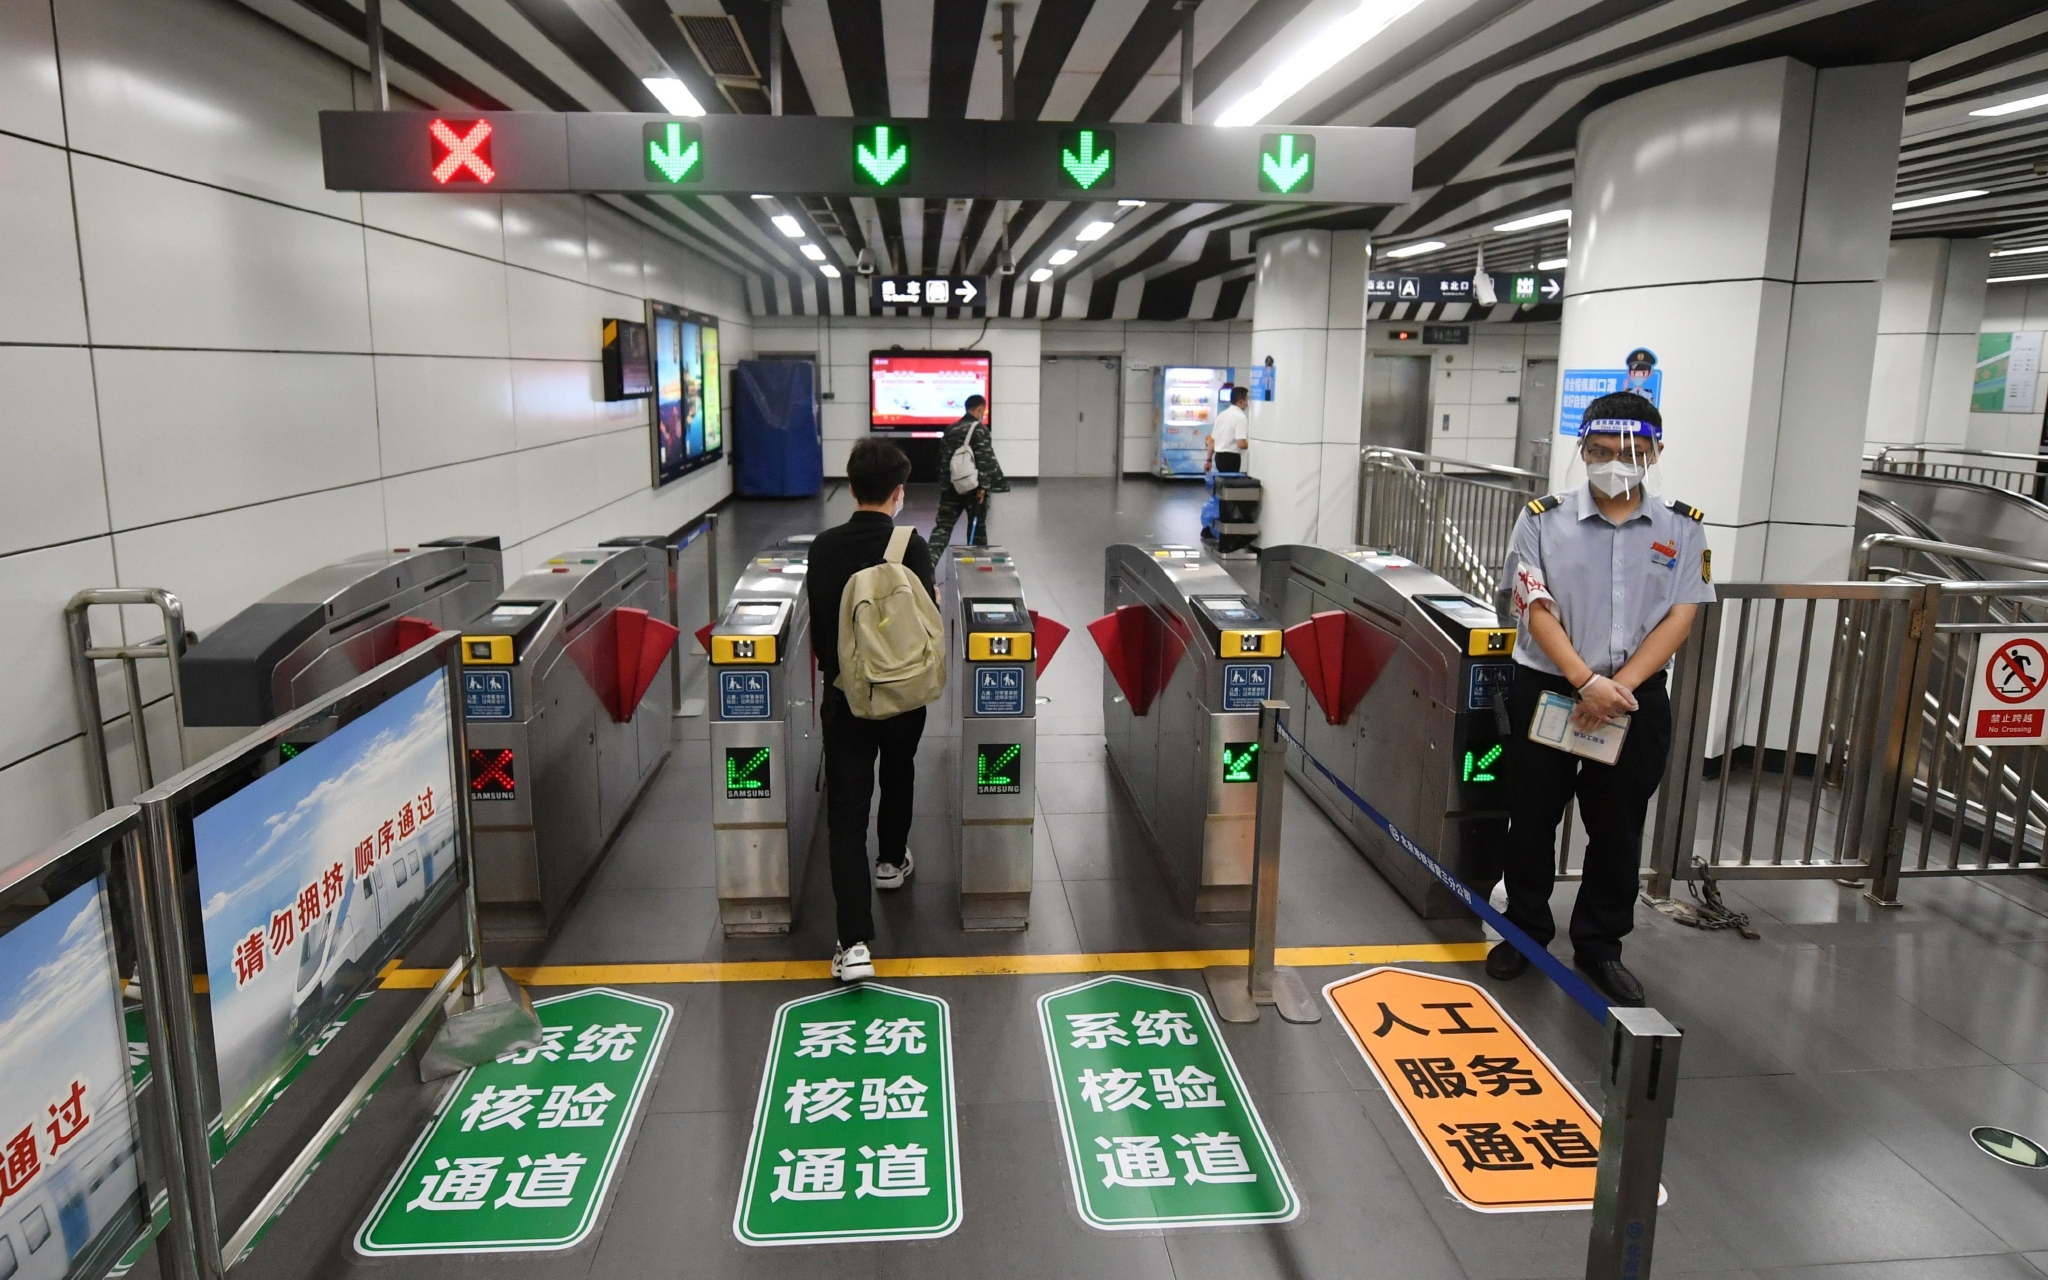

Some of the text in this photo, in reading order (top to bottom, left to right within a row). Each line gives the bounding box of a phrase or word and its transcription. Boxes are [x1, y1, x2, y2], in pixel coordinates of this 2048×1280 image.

[1402, 280, 1416, 296] A
[1440, 281, 1469, 291] 东北口
[1990, 714, 2033, 723] 禁止跨越
[2001, 725, 2032, 733] Crossing
[471, 792, 515, 800] SAMSUNG
[727, 789, 770, 797] SAMSUNG
[978, 785, 1020, 793] SAMSUNG
[235, 786, 435, 986] 请勿拥挤 顺序通过
[794, 1017, 928, 1058] 系统
[1065, 1009, 1199, 1050] 系统
[1372, 1002, 1500, 1038] 人工
[496, 1023, 643, 1065] 系统
[1077, 1065, 1227, 1113] 核验
[1394, 1054, 1544, 1100] 服务
[460, 1082, 617, 1133] 核验
[784, 1075, 929, 1124] 核验
[0, 1080, 90, 1208] 通过
[1093, 1131, 1258, 1190] 通道
[1437, 1118, 1600, 1174] 通道
[405, 1152, 588, 1214] 通道
[769, 1142, 932, 1204] 通道
